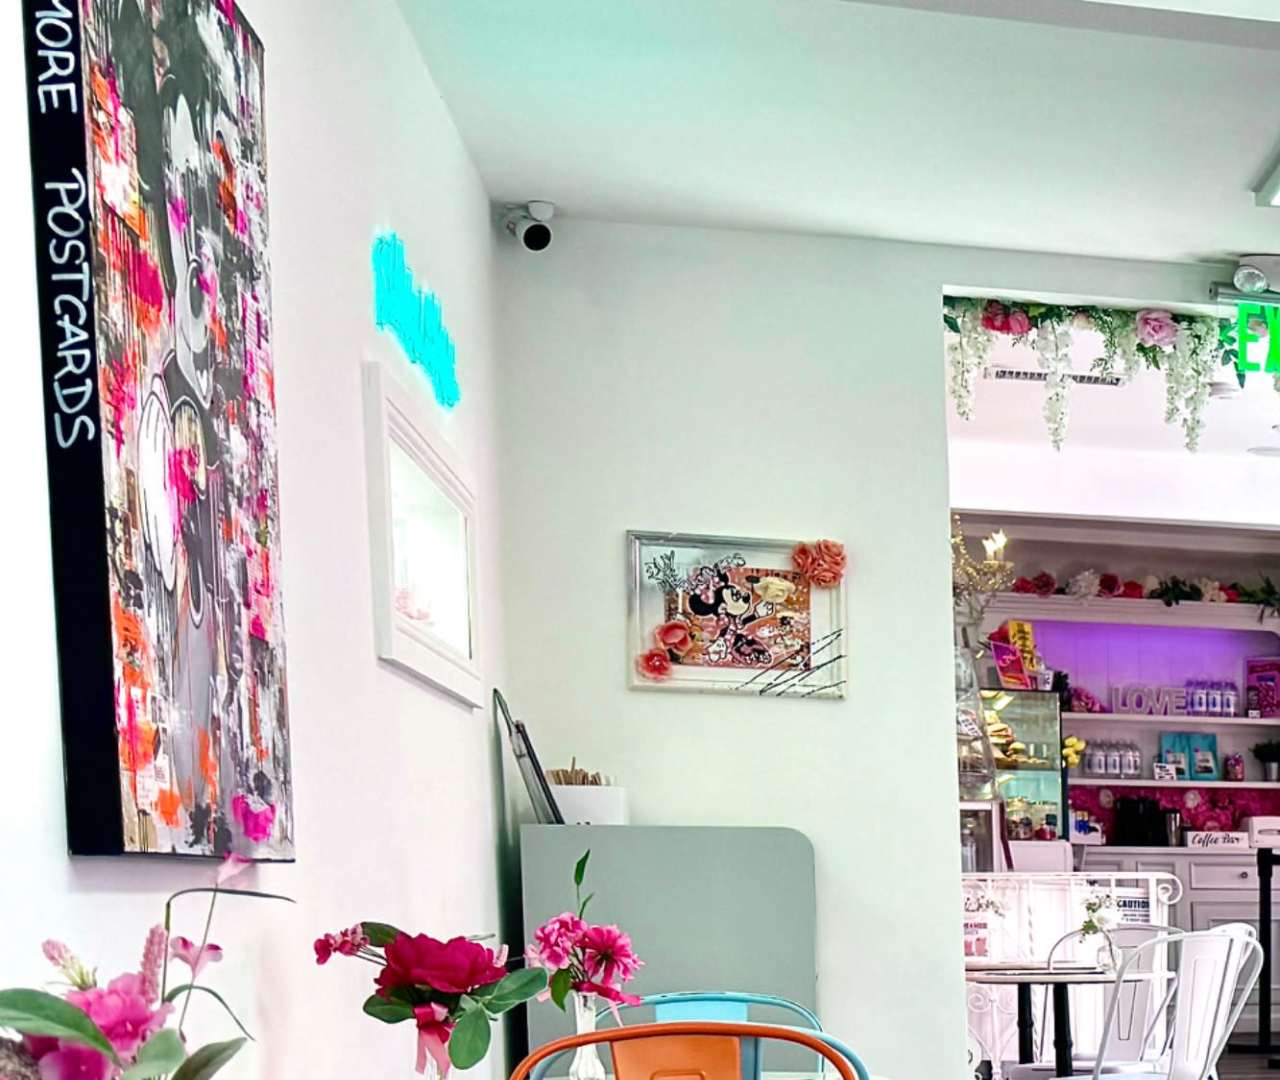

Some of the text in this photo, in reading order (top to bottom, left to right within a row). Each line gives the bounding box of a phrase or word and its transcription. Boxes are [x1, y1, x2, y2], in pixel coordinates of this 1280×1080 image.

[45, 167, 95, 448] POSTCARDS
[1112, 685, 1186, 715] LOVE
[1192, 833, 1219, 848] Coffee
